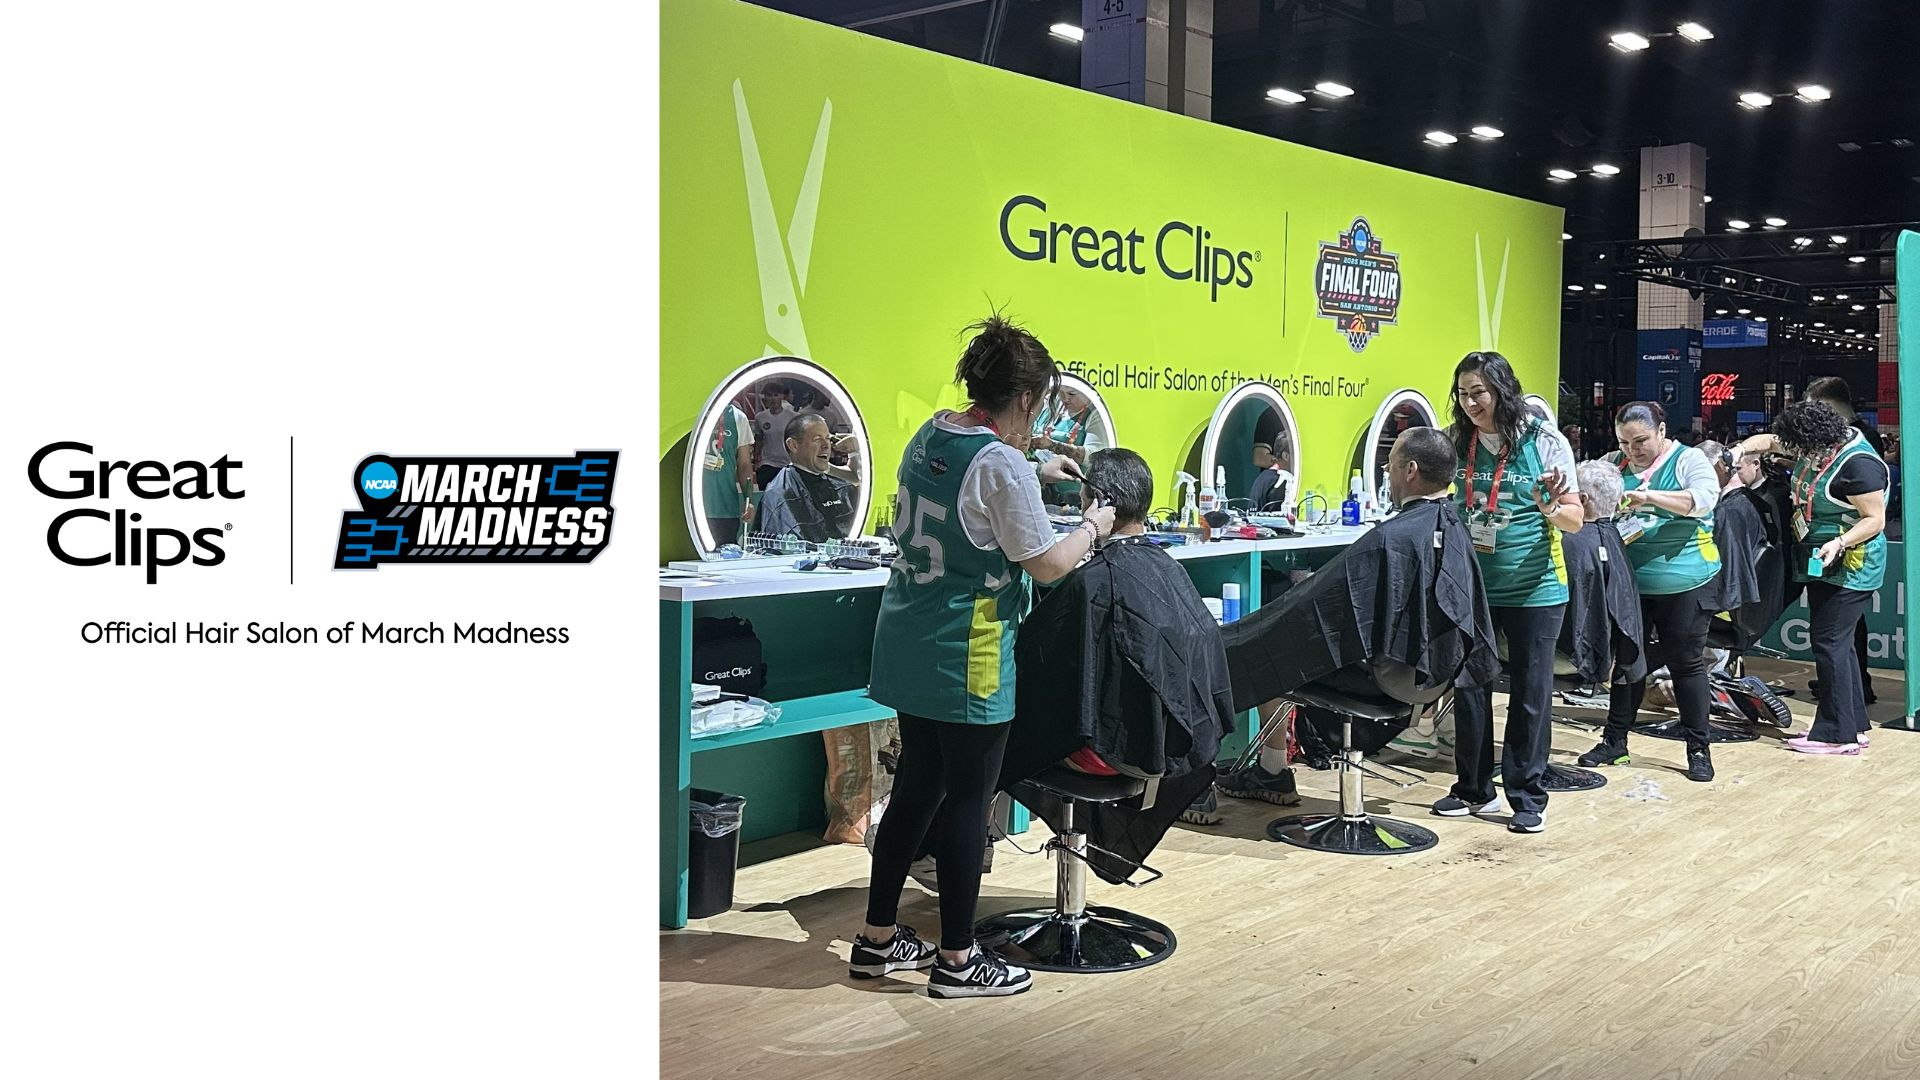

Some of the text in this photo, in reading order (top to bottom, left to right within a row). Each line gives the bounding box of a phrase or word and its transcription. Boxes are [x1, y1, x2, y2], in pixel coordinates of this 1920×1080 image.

[999, 195, 1254, 302] Great Clips
[1320, 262, 1399, 300] FINAL FOUR
[1703, 326, 1738, 336] ERADE
[1124, 364, 1160, 389] Hair
[1163, 367, 1207, 391] Salon
[1211, 369, 1228, 392] of
[1230, 370, 1254, 389] th
[1303, 375, 1334, 396] Final
[1337, 376, 1366, 398] Four
[1456, 468, 1494, 481] Geat
[1780, 618, 1905, 660] Gat
[704, 667, 752, 681] Great Clips
